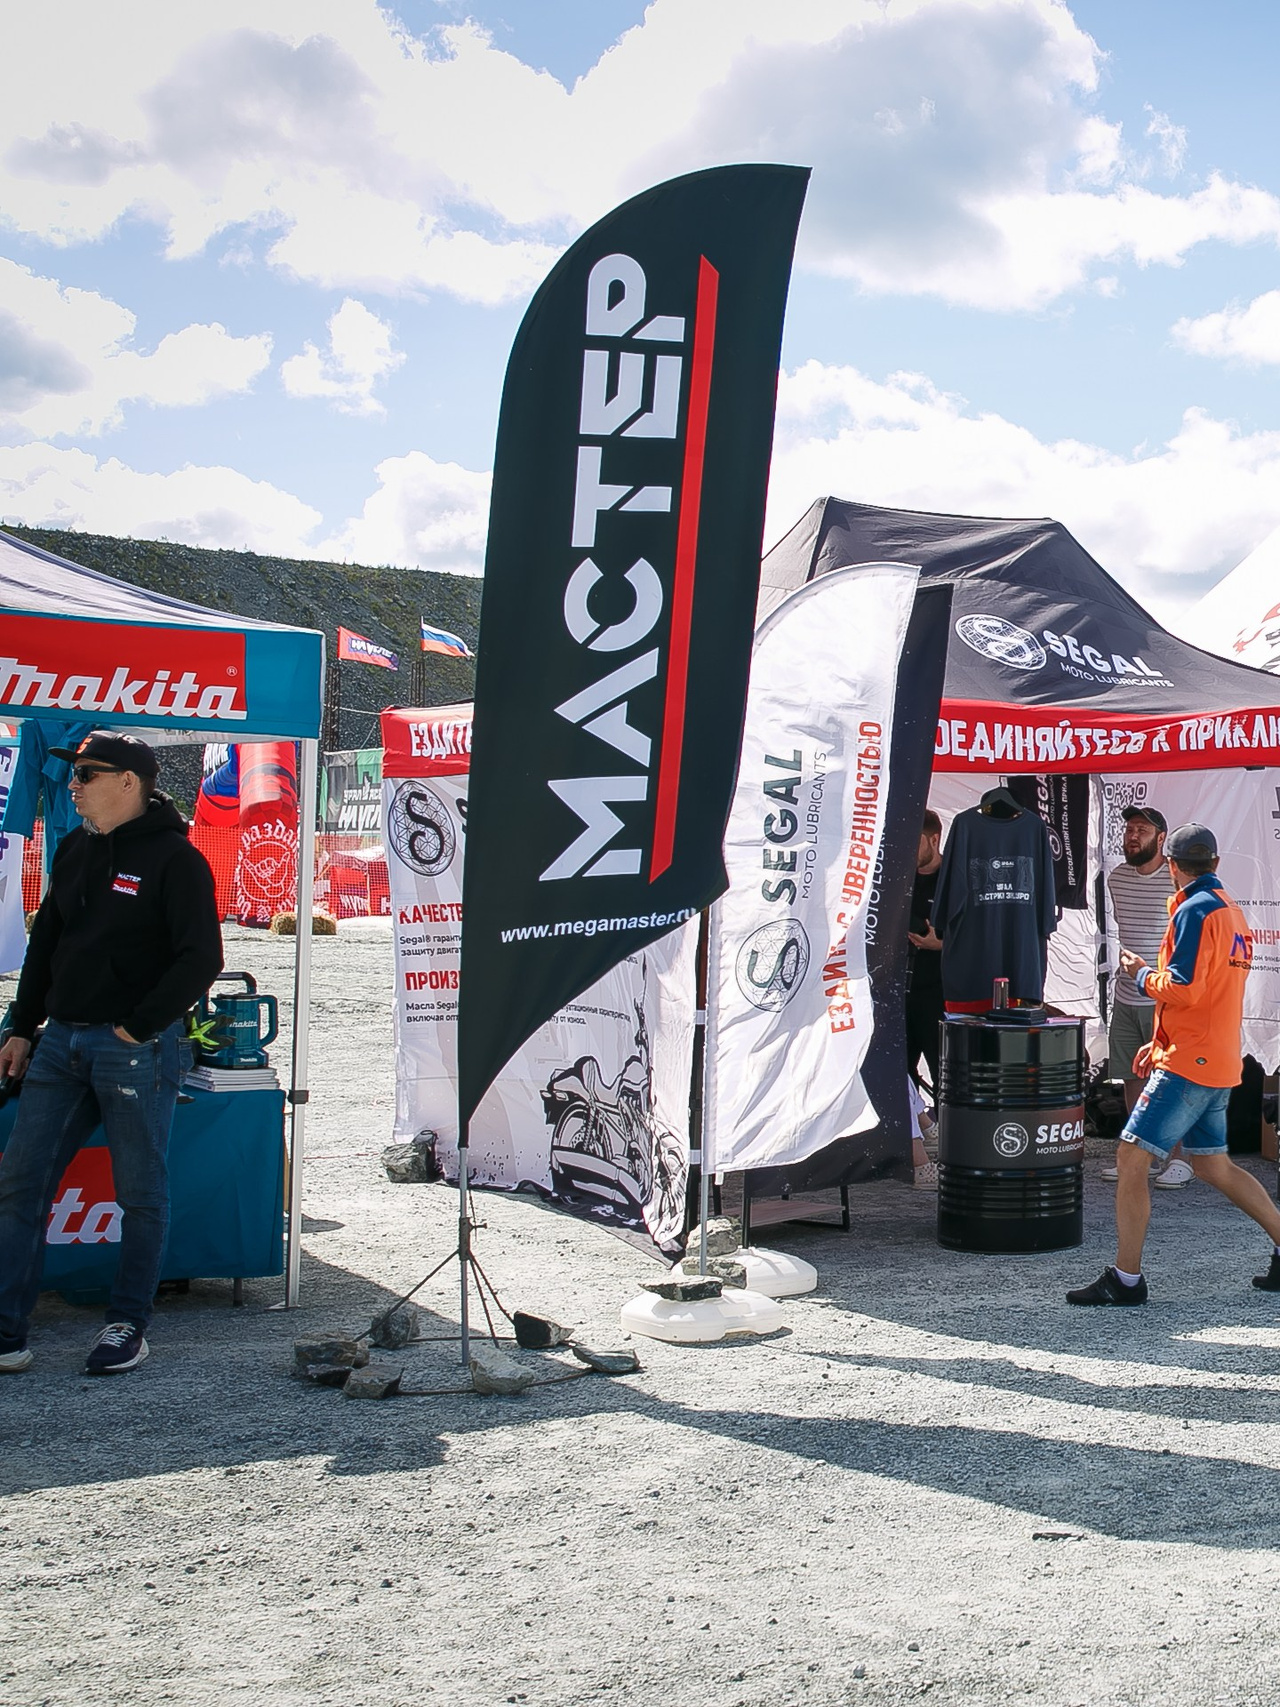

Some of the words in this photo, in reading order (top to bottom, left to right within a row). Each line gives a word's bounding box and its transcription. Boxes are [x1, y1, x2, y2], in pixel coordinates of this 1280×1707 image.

[1043, 630, 1163, 677] SEGAL
[1060, 661, 1094, 680] MOTO
[1096, 674, 1174, 687] LUBRICANTS
[935, 719, 1147, 764] ОЕДИНЯЙТЕСЬ
[805, 751, 827, 845] LUBRICANTS
[761, 749, 802, 906] SEGAL
[801, 847, 818, 899] MOTO
[399, 903, 463, 924] КАЧЕСТВ
[501, 907, 697, 943] www.megamaster.ru
[437, 947, 461, 955] двигат
[405, 970, 461, 991] ПРОИЗ
[436, 1001, 459, 1012] Segal
[1036, 1146, 1058, 1155] MOTO
